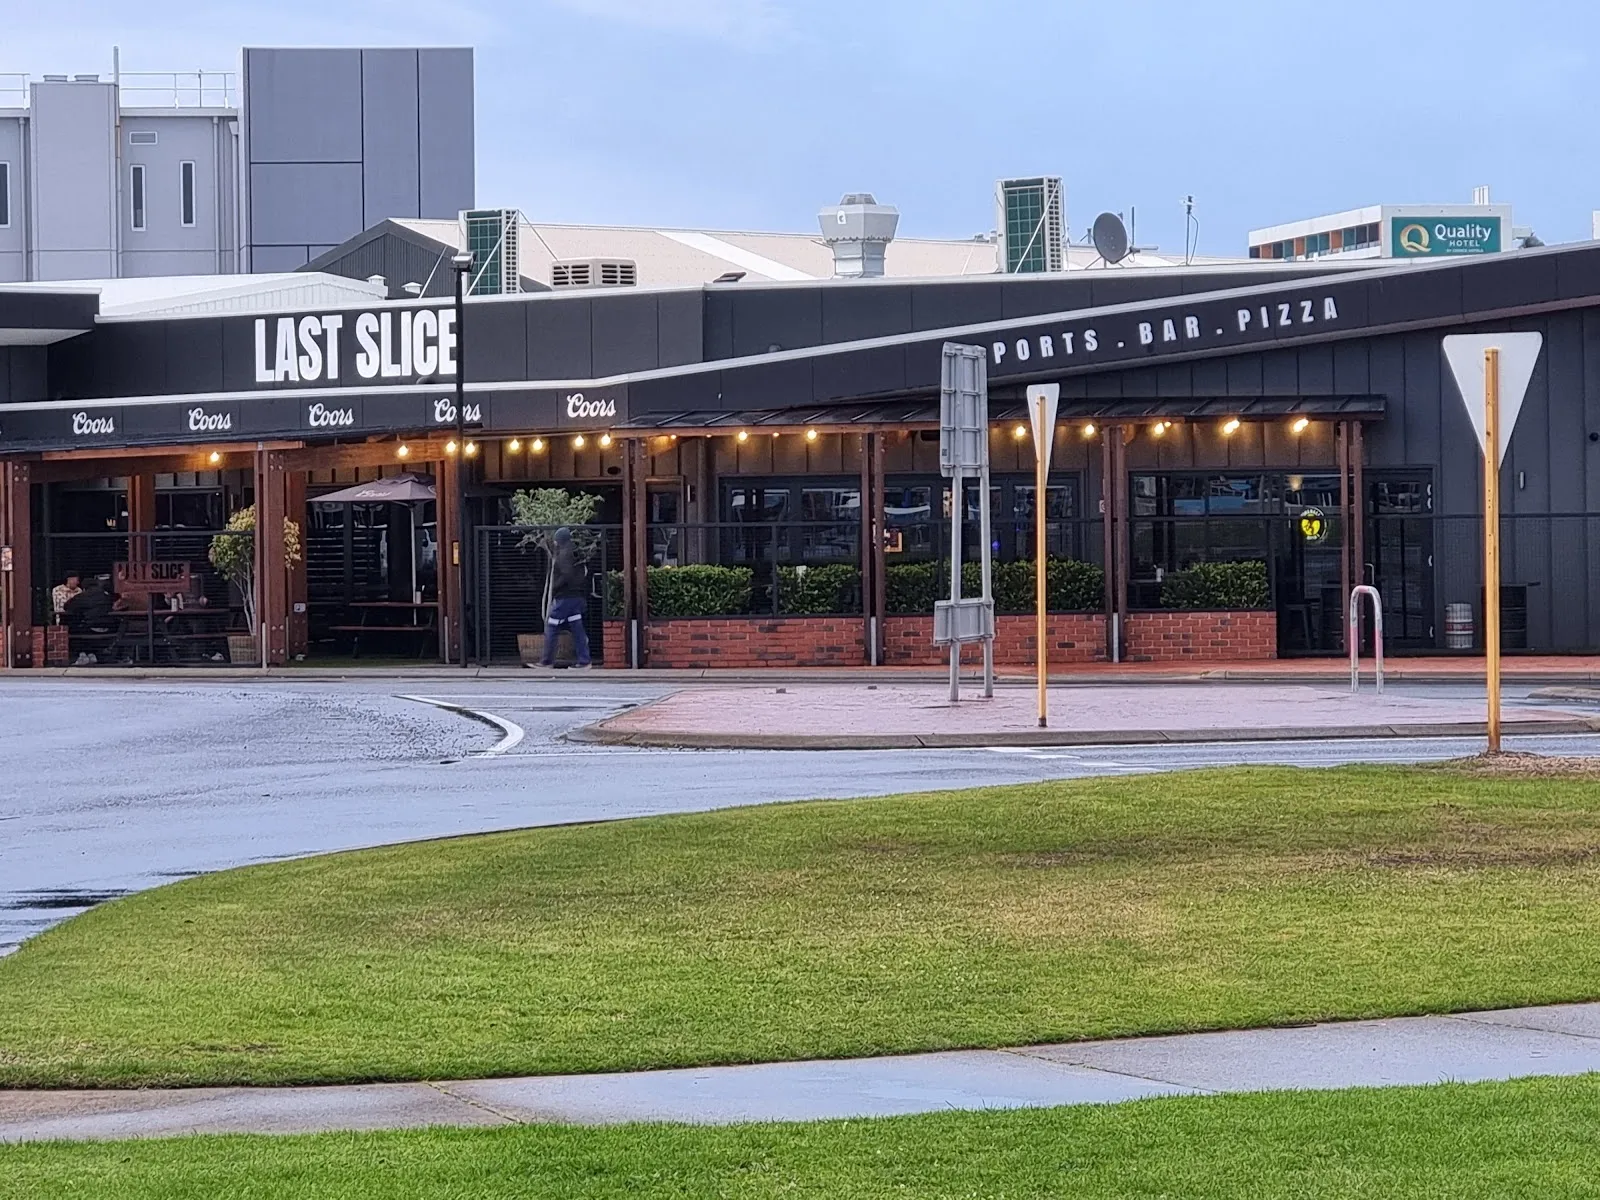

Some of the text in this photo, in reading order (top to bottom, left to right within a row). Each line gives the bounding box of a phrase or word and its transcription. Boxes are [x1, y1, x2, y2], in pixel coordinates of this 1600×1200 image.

[1434, 223, 1492, 242] Quality
[1449, 239, 1480, 247] HOTEL
[992, 329, 1099, 364] PORTS
[1138, 316, 1200, 345] BAR
[1237, 297, 1339, 332] PIZZA
[255, 308, 457, 382] LAST SLICE
[308, 402, 355, 427] Coors
[434, 398, 482, 423] Cors
[567, 393, 617, 418] Coors
[72, 411, 115, 435] Coors
[188, 407, 232, 431] Coors
